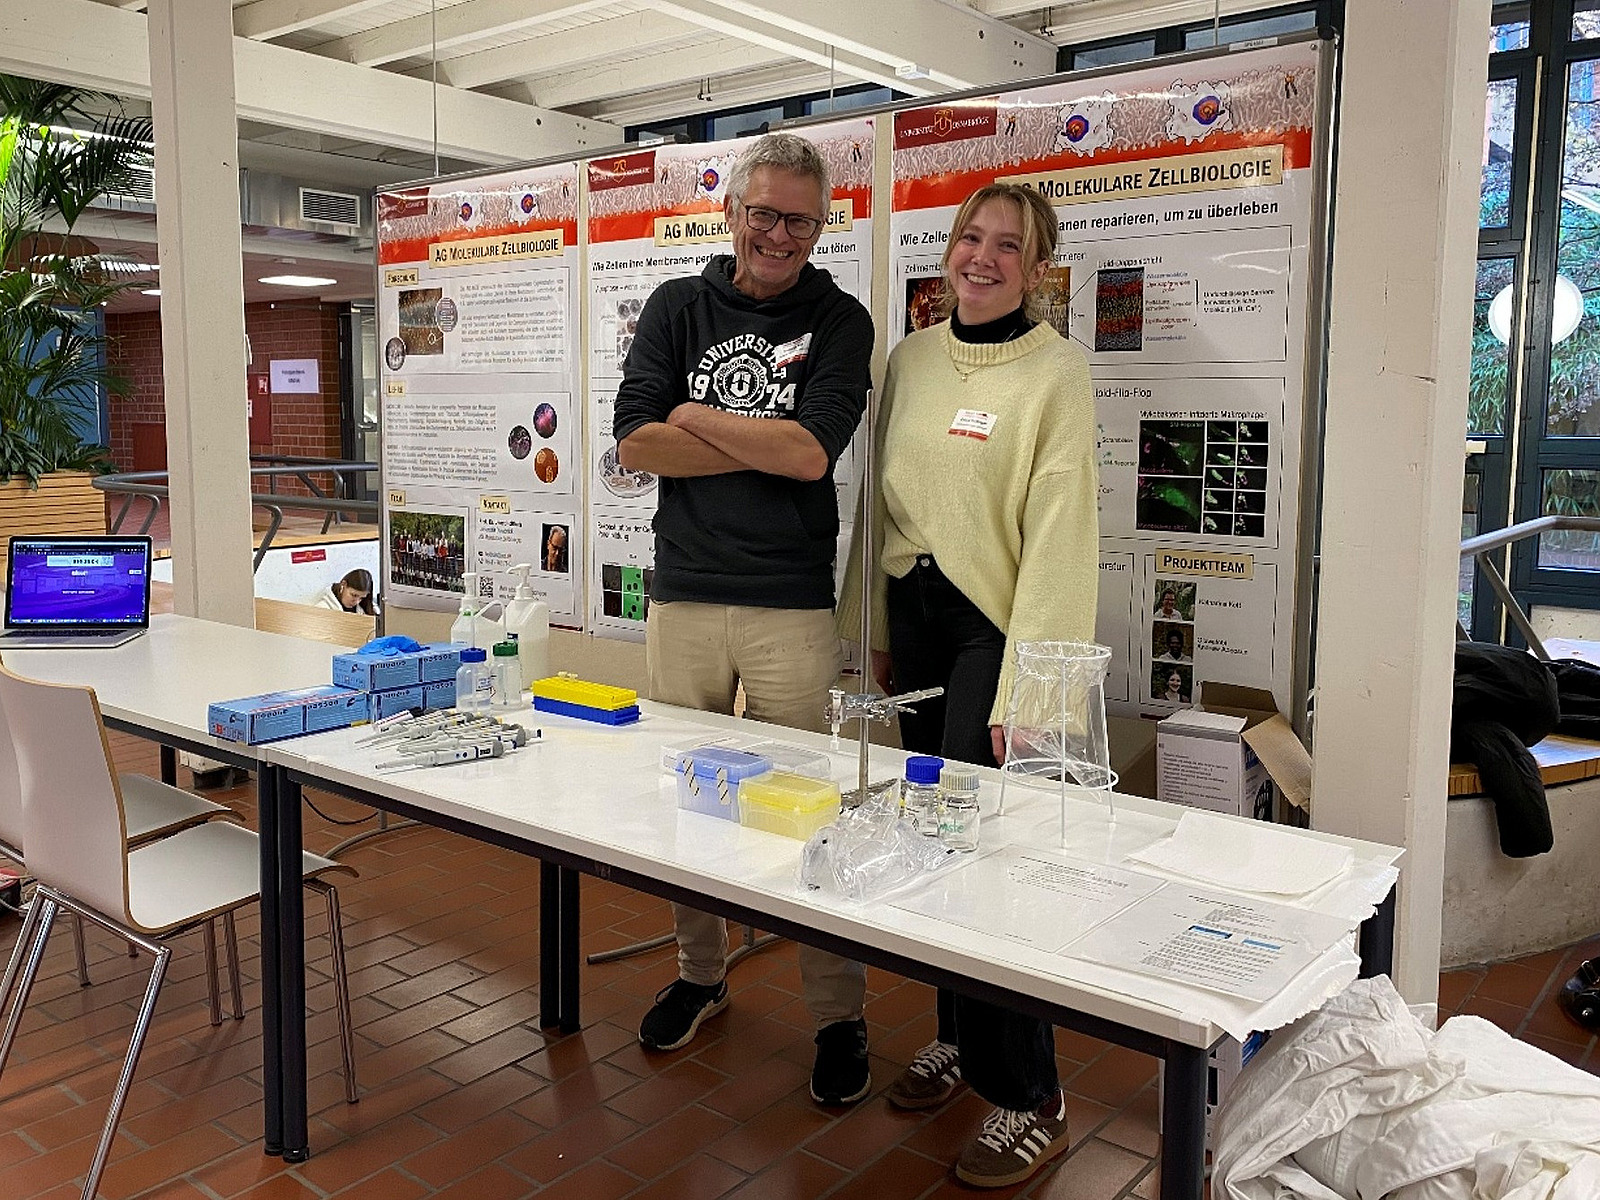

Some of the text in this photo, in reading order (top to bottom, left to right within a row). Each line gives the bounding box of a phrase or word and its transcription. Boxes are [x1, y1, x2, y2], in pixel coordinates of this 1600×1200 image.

[1038, 173, 1142, 199] MOLEKULARE
[1147, 159, 1272, 188] ZELLBIOLOGIE
[664, 224, 681, 240] AG
[685, 222, 731, 238] MOLEKU
[900, 233, 919, 246] Wie
[1091, 211, 1159, 231] reparieren,
[1164, 210, 1184, 222] um
[1187, 207, 1203, 220] zu
[1207, 201, 1278, 218] überleben
[501, 238, 558, 255] ZELLBIOLOGIE
[816, 246, 829, 254] zu
[830, 242, 856, 253] töten
[698, 333, 787, 379] UNIVERSITT
[765, 383, 797, 411] 74
[1163, 555, 1245, 573] PROJEKTTEAM
